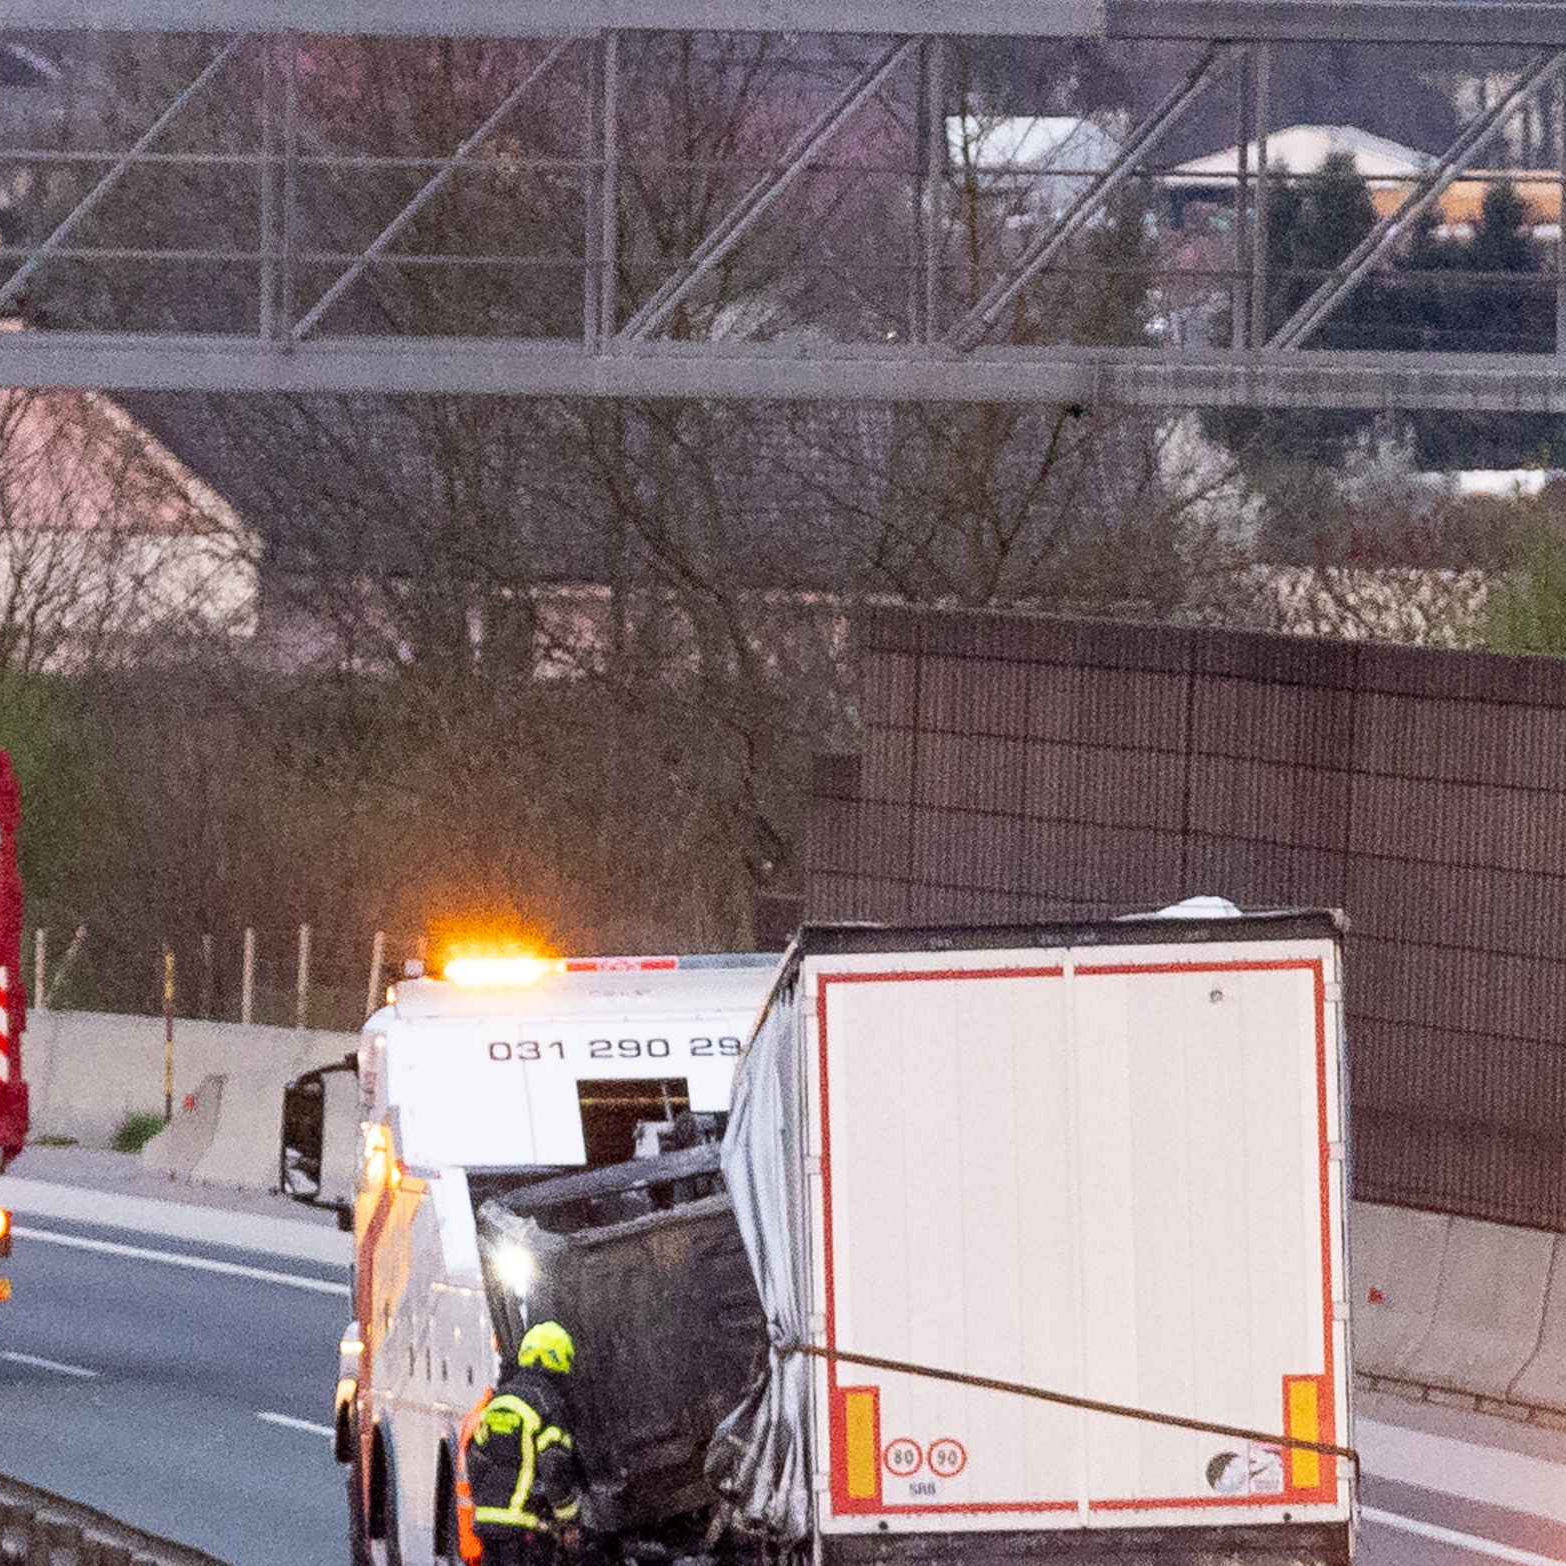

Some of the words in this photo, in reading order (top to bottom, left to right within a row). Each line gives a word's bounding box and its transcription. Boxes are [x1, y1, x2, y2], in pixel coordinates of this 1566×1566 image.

[489, 1041, 565, 1061] 031
[589, 1038, 670, 1059] 290
[894, 1449, 914, 1466] 80
[937, 1449, 957, 1467] 90
